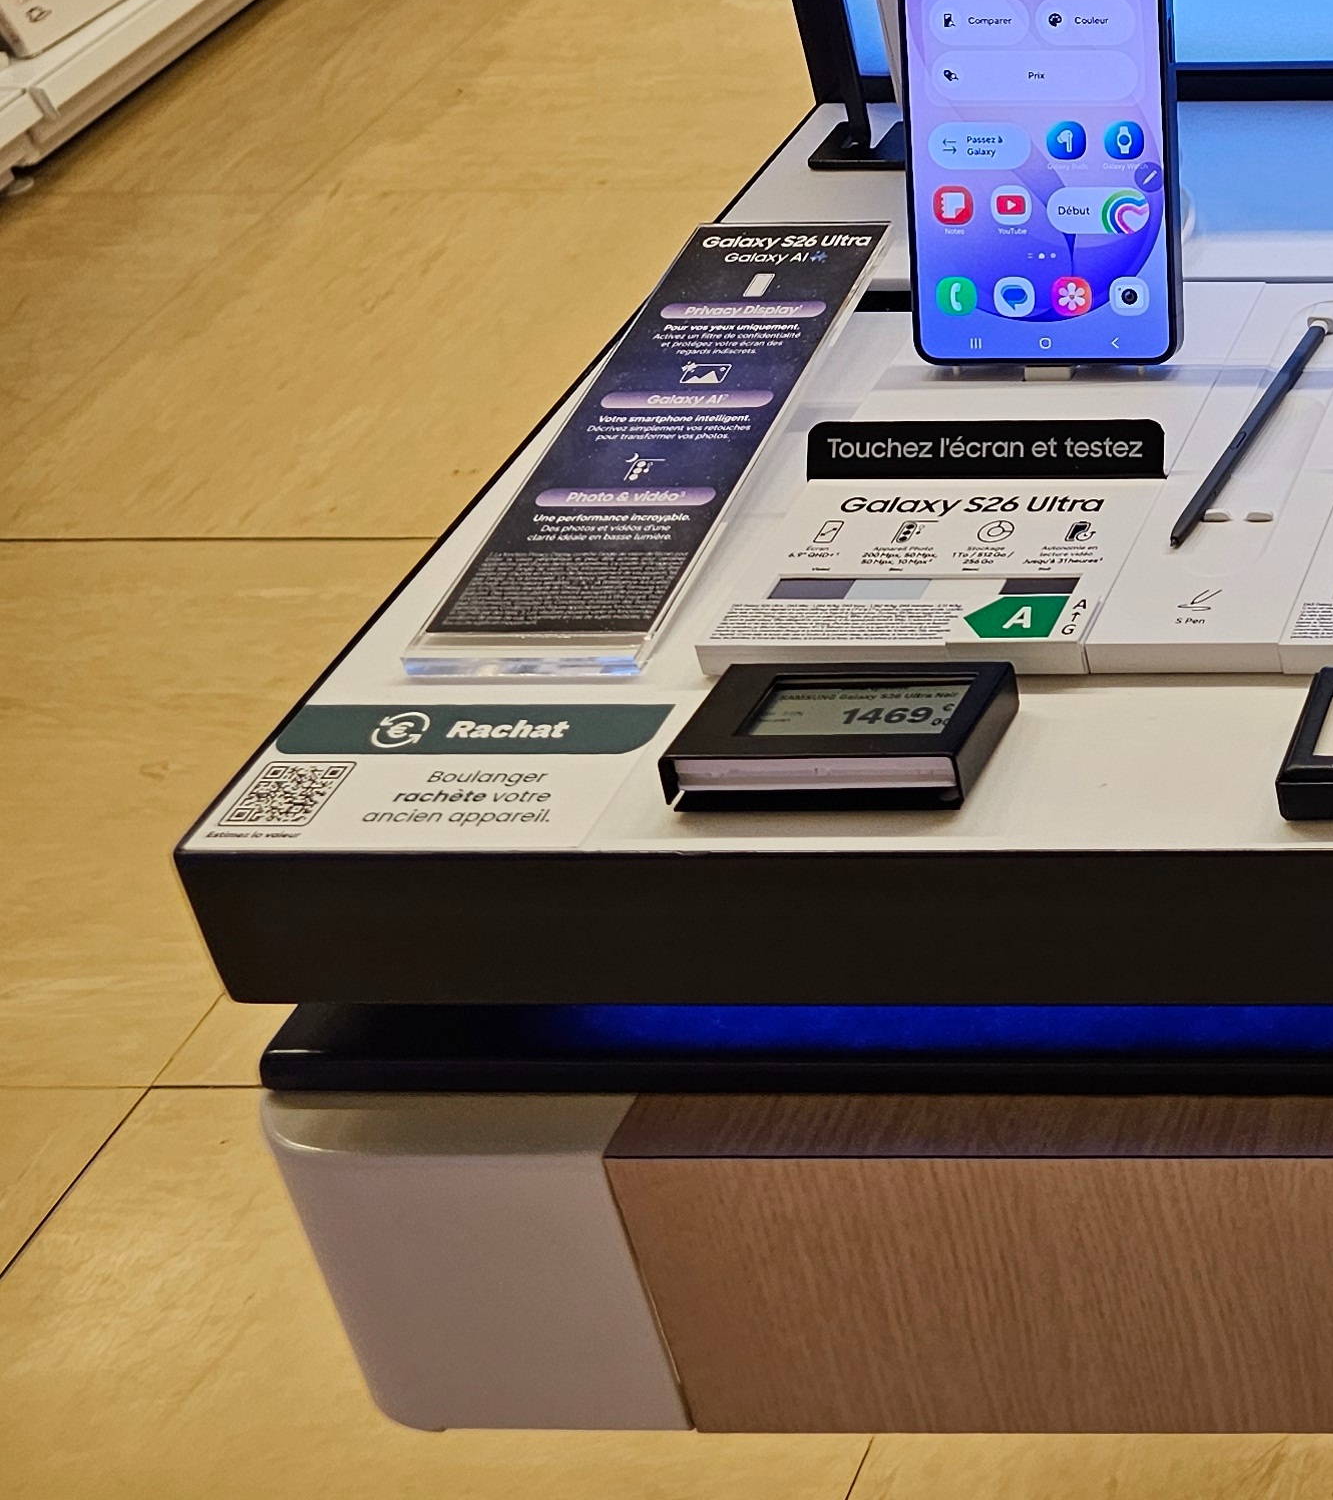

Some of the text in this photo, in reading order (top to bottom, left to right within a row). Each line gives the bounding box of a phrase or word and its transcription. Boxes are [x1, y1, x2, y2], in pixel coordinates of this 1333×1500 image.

[968, 16, 1012, 26] Comparer
[1074, 16, 1108, 24] Couleur
[1028, 71, 1045, 79] Prix
[1058, 205, 1090, 216] Début
[944, 227, 965, 235] Notes
[998, 227, 1027, 235] YouTube
[702, 234, 872, 251] Galaxy S26 Ultra
[724, 252, 809, 265] Galaxy AI
[628, 415, 693, 423] smartphone
[695, 415, 750, 423] intelligent.
[827, 438, 1143, 459] Touchez l'écran et testez
[840, 496, 1104, 517] Galaxy S26 Ultra
[1006, 606, 1032, 629] A
[843, 707, 933, 725] 1469
[446, 720, 571, 740] Rachat
[427, 771, 548, 786] Boulanger
[393, 789, 551, 803] rachète votre
[362, 808, 550, 826] ancien appareil.
[205, 831, 249, 839] Estimez
